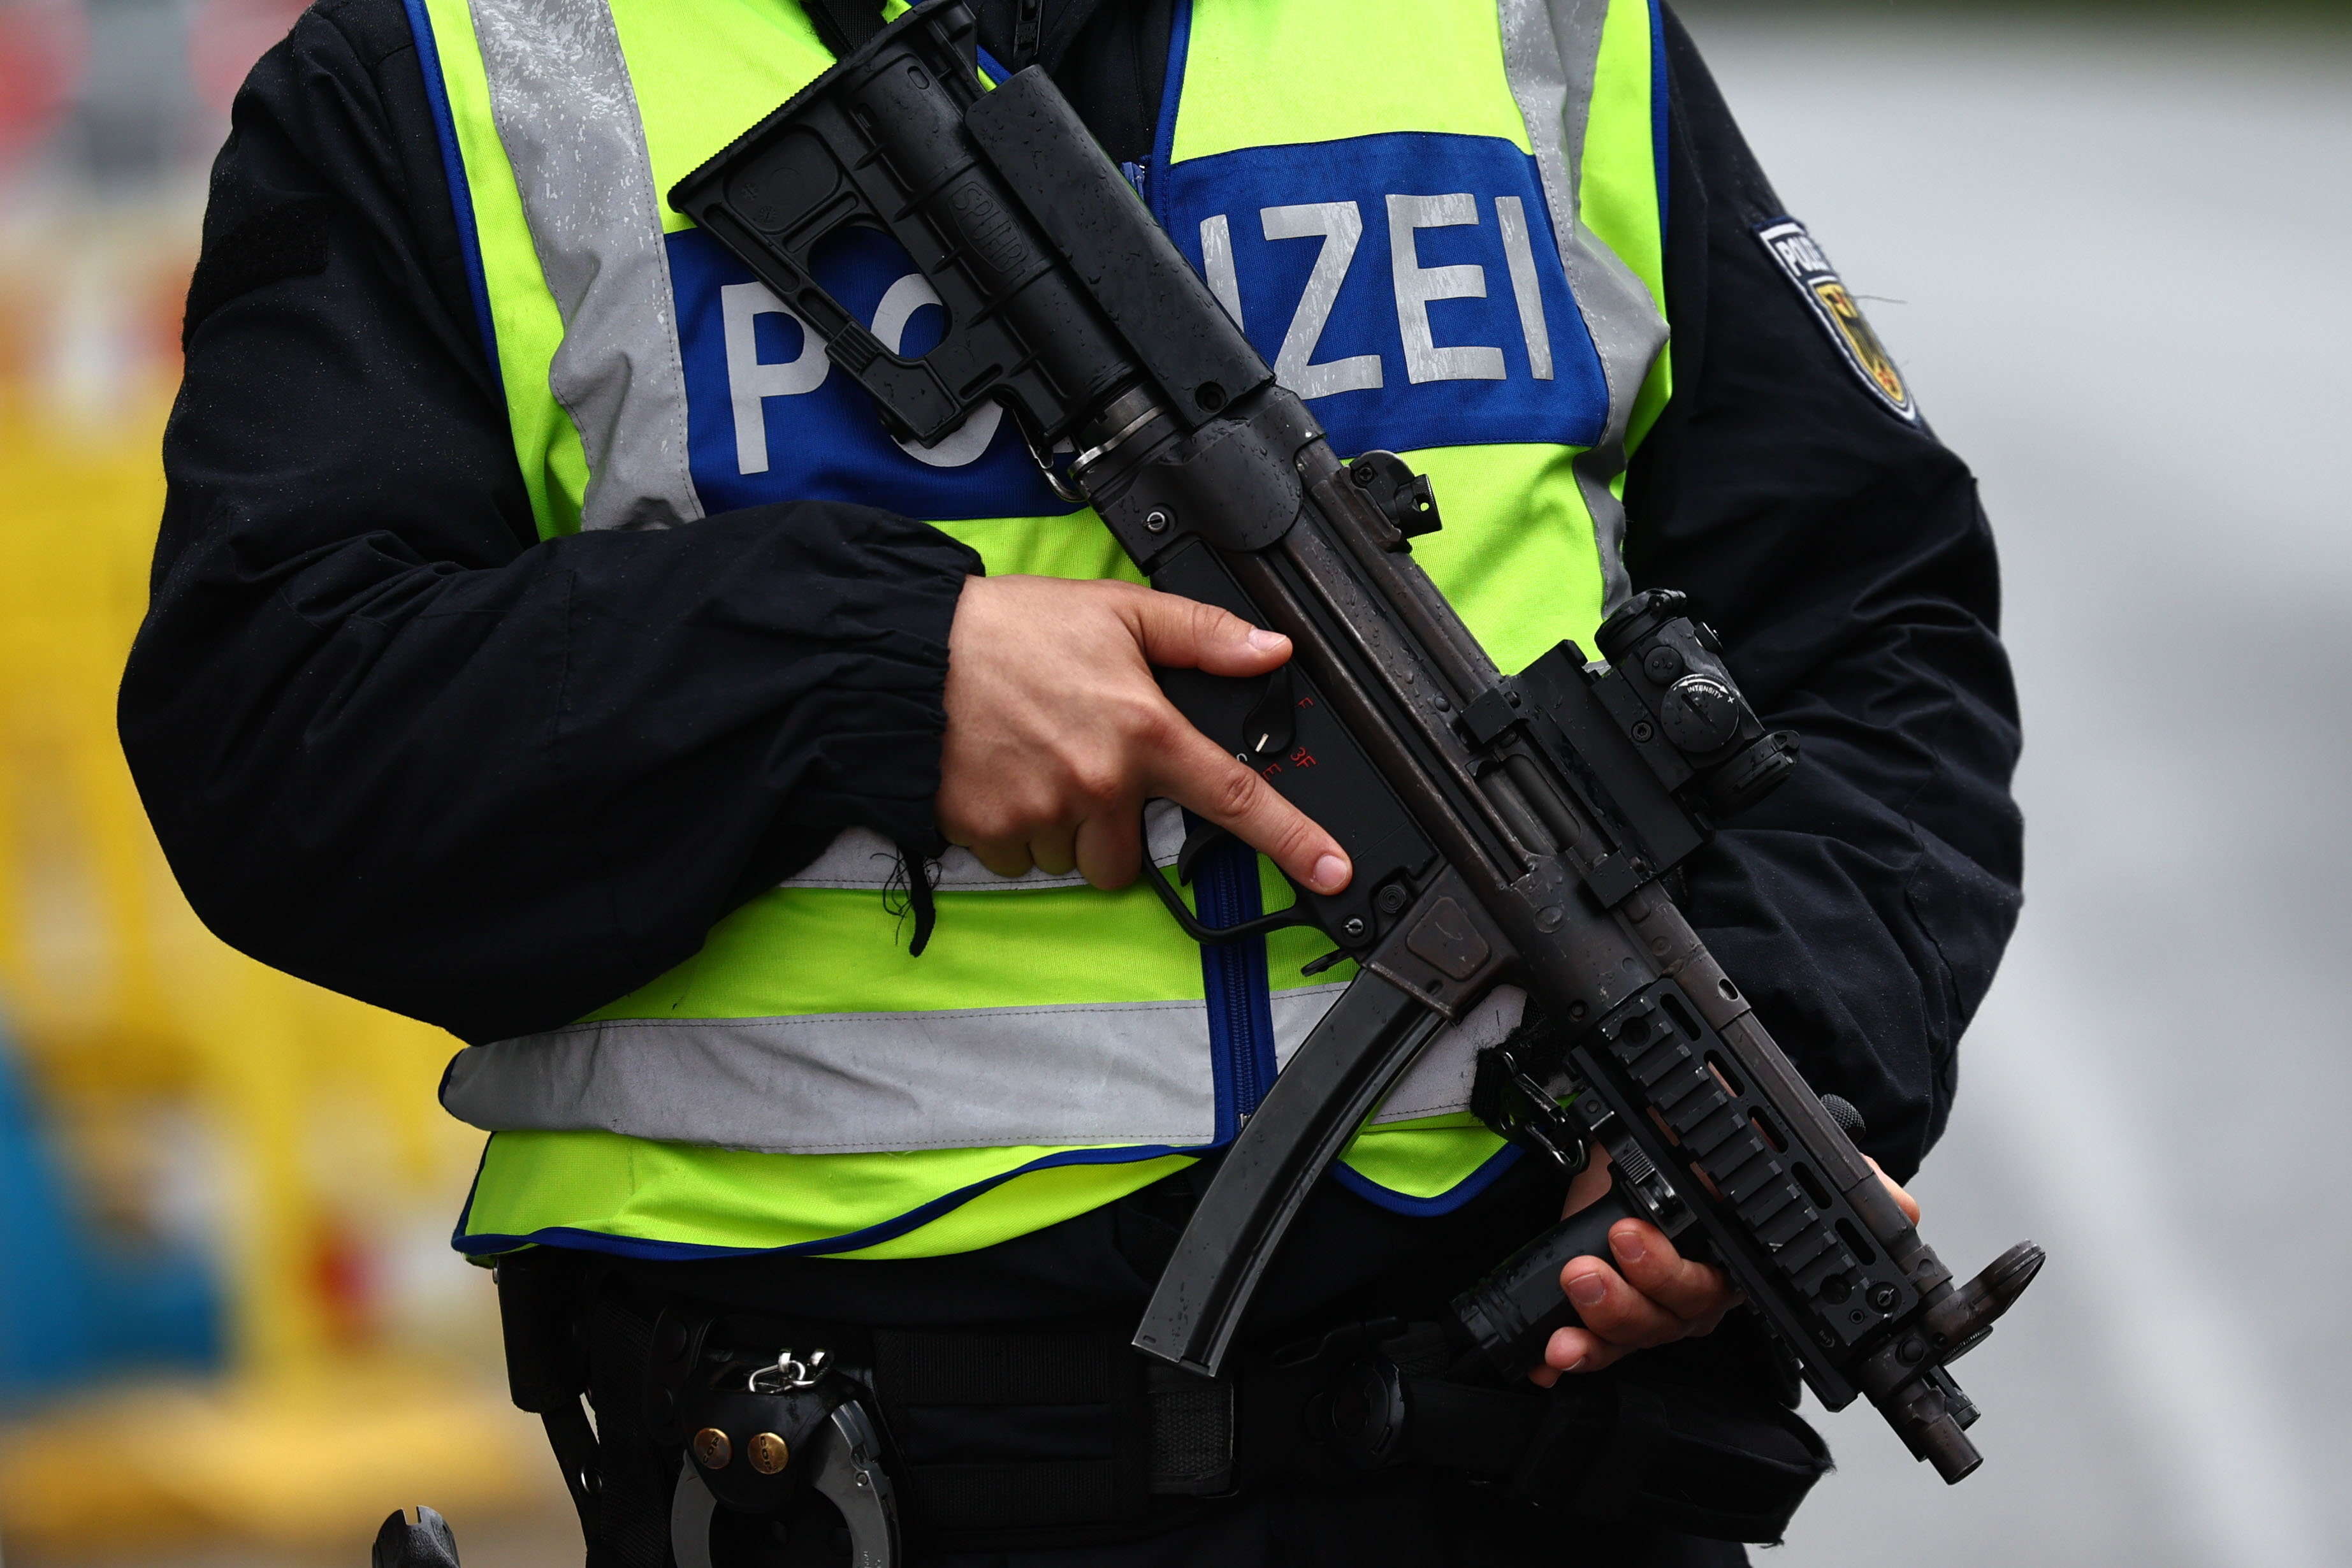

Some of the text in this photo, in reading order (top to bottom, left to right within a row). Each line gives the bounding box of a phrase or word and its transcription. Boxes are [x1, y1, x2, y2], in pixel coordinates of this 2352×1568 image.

[952, 188, 1022, 269] SPUHR
[721, 192, 1553, 475] POIZEI
[1687, 684, 1723, 699] INTENSITY
[1298, 697, 1313, 709] F
[1290, 746, 1316, 767] 3F
